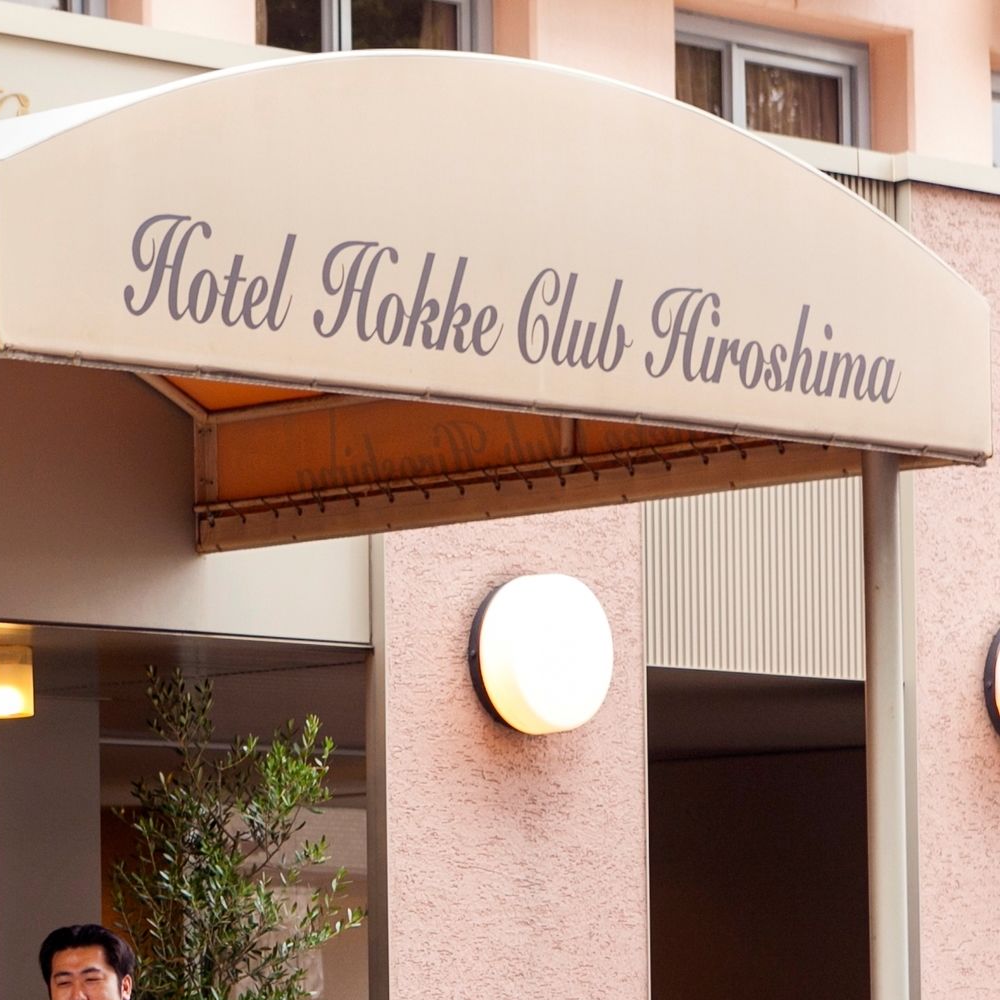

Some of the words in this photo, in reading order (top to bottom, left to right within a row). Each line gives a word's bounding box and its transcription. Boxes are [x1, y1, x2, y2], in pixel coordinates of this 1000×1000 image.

[123, 213, 297, 332] Hotel
[313, 240, 504, 357] Hokke
[517, 267, 634, 373] Club
[644, 287, 902, 404] Hiroshima
